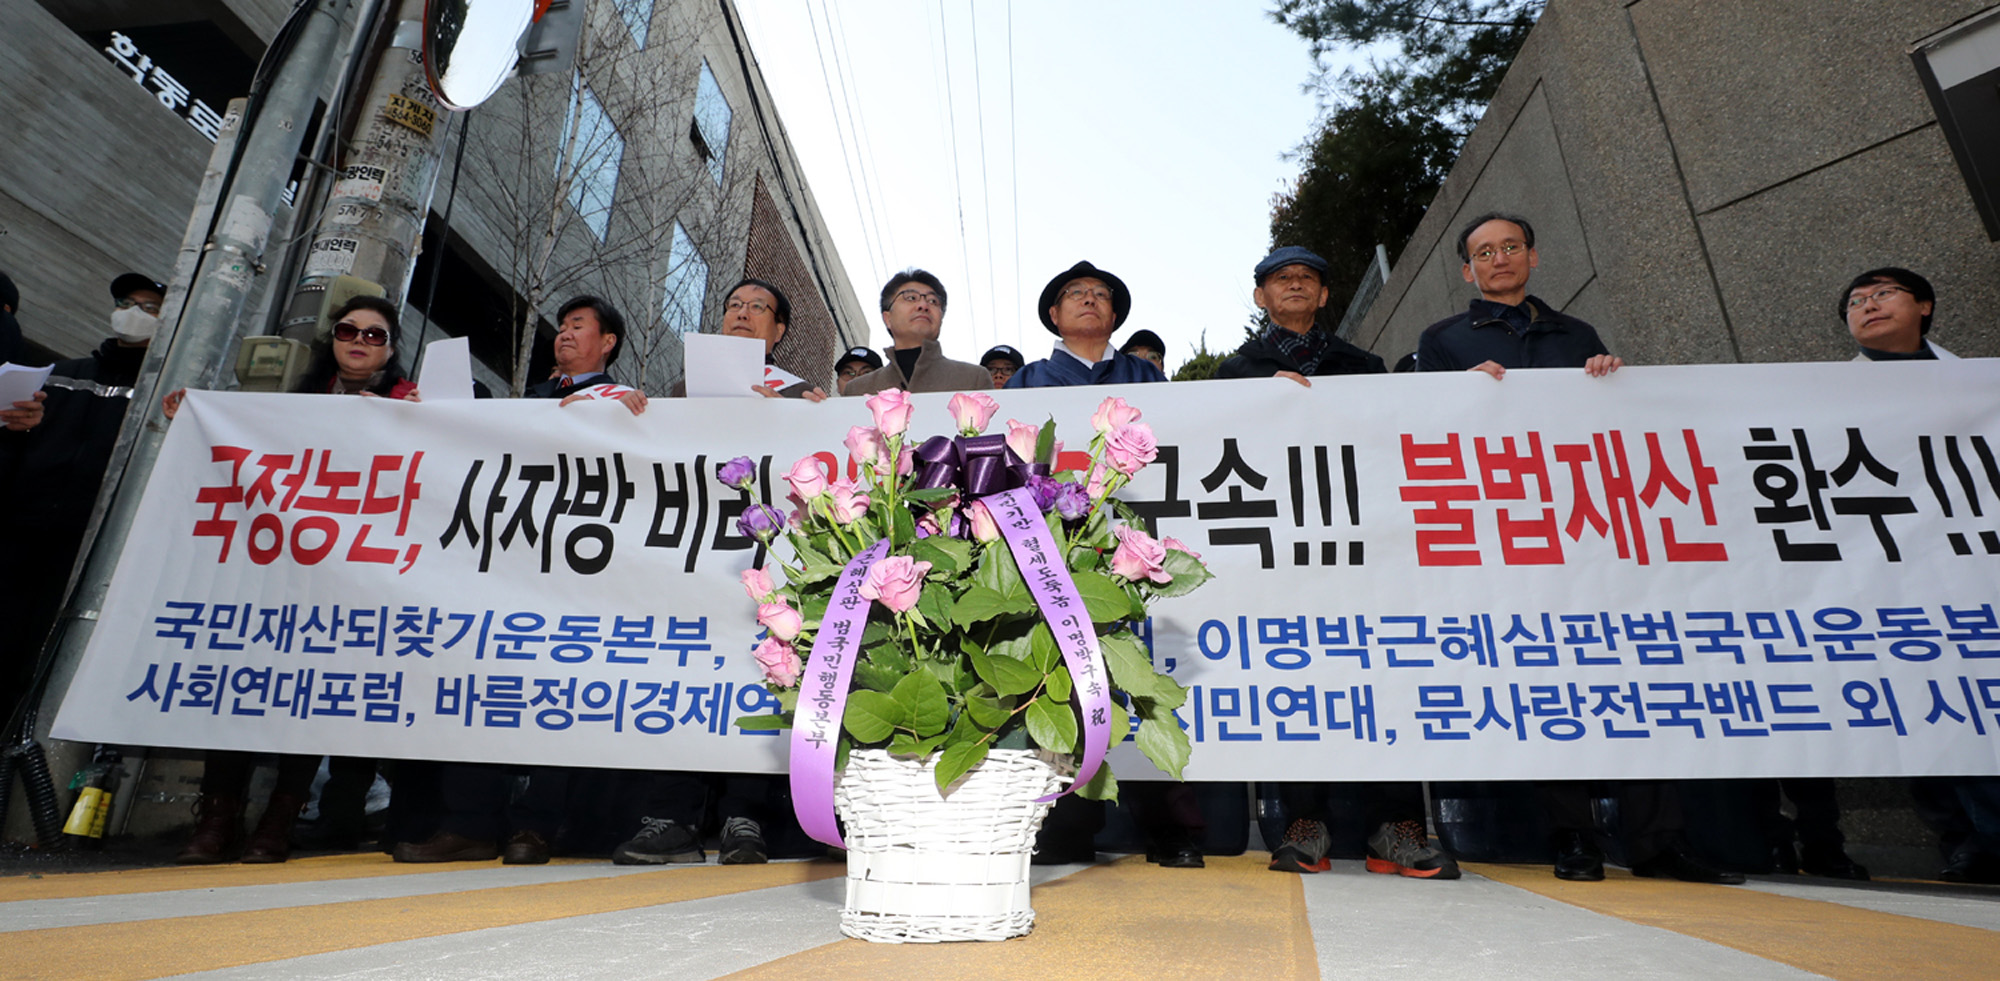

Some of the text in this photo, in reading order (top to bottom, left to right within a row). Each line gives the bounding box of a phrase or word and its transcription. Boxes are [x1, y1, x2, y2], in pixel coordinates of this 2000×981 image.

[105, 30, 223, 145] 학동로
[193, 445, 425, 575] 국정농단,
[440, 453, 635, 575] 사자방
[645, 455, 773, 573] 비리
[1399, 428, 1729, 566] 불법재산
[155, 601, 725, 671] 국민재산되찾기운동본부,
[1198, 603, 2000, 670] 이명박근혜심판범국민운동본
[805, 619, 852, 750] 범국민행동본부
[1061, 614, 1101, 698] 이명박구속
[1091, 706, 1106, 726] 祝
[127, 662, 414, 728] 사회연대포럼,
[435, 672, 783, 736] 바름정의경제연
[1415, 680, 1832, 741] 문사랑전국밴드
[1842, 678, 1908, 737] 외
